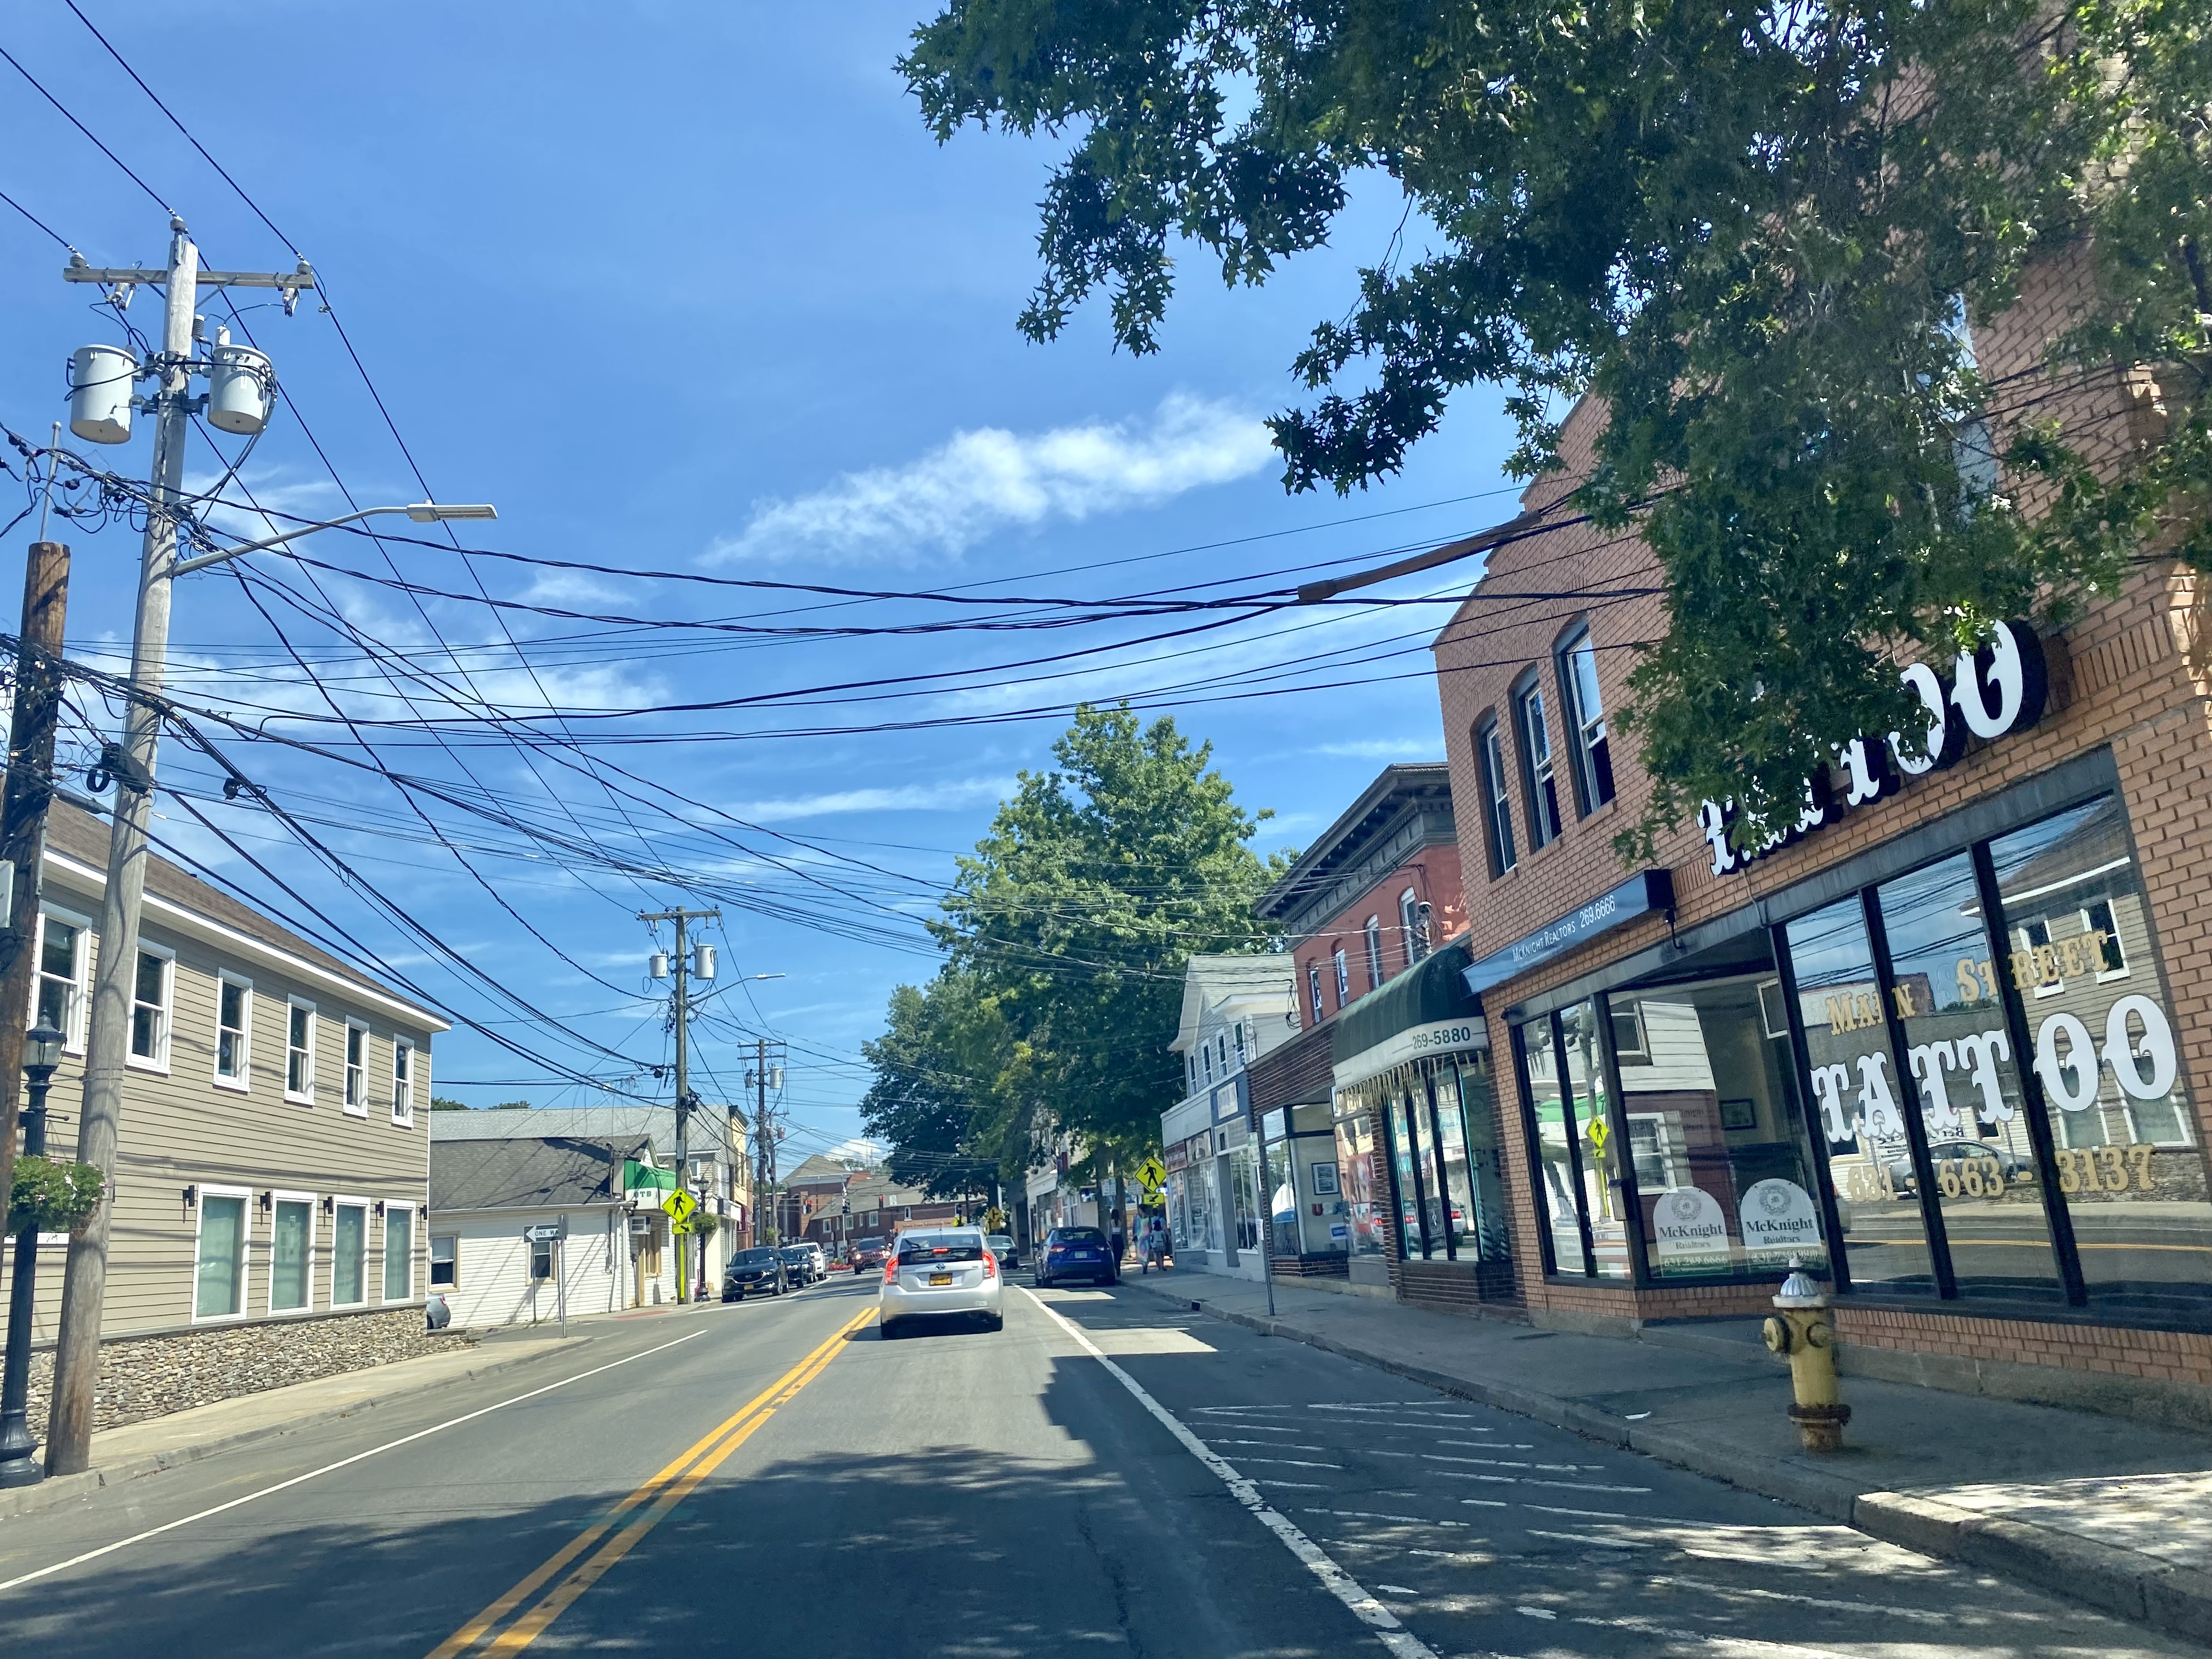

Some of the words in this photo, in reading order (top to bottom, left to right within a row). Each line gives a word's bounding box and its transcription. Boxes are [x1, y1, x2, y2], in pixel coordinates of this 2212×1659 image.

[1579, 895, 1616, 928] 269.6666
[1956, 930, 2108, 1002] STREET
[1412, 1026, 1471, 1050] 269-5880
[1811, 995, 2177, 1143] TATTOO
[1658, 1223, 1723, 1238] McKnight
[1746, 1217, 1813, 1233] McKnight
